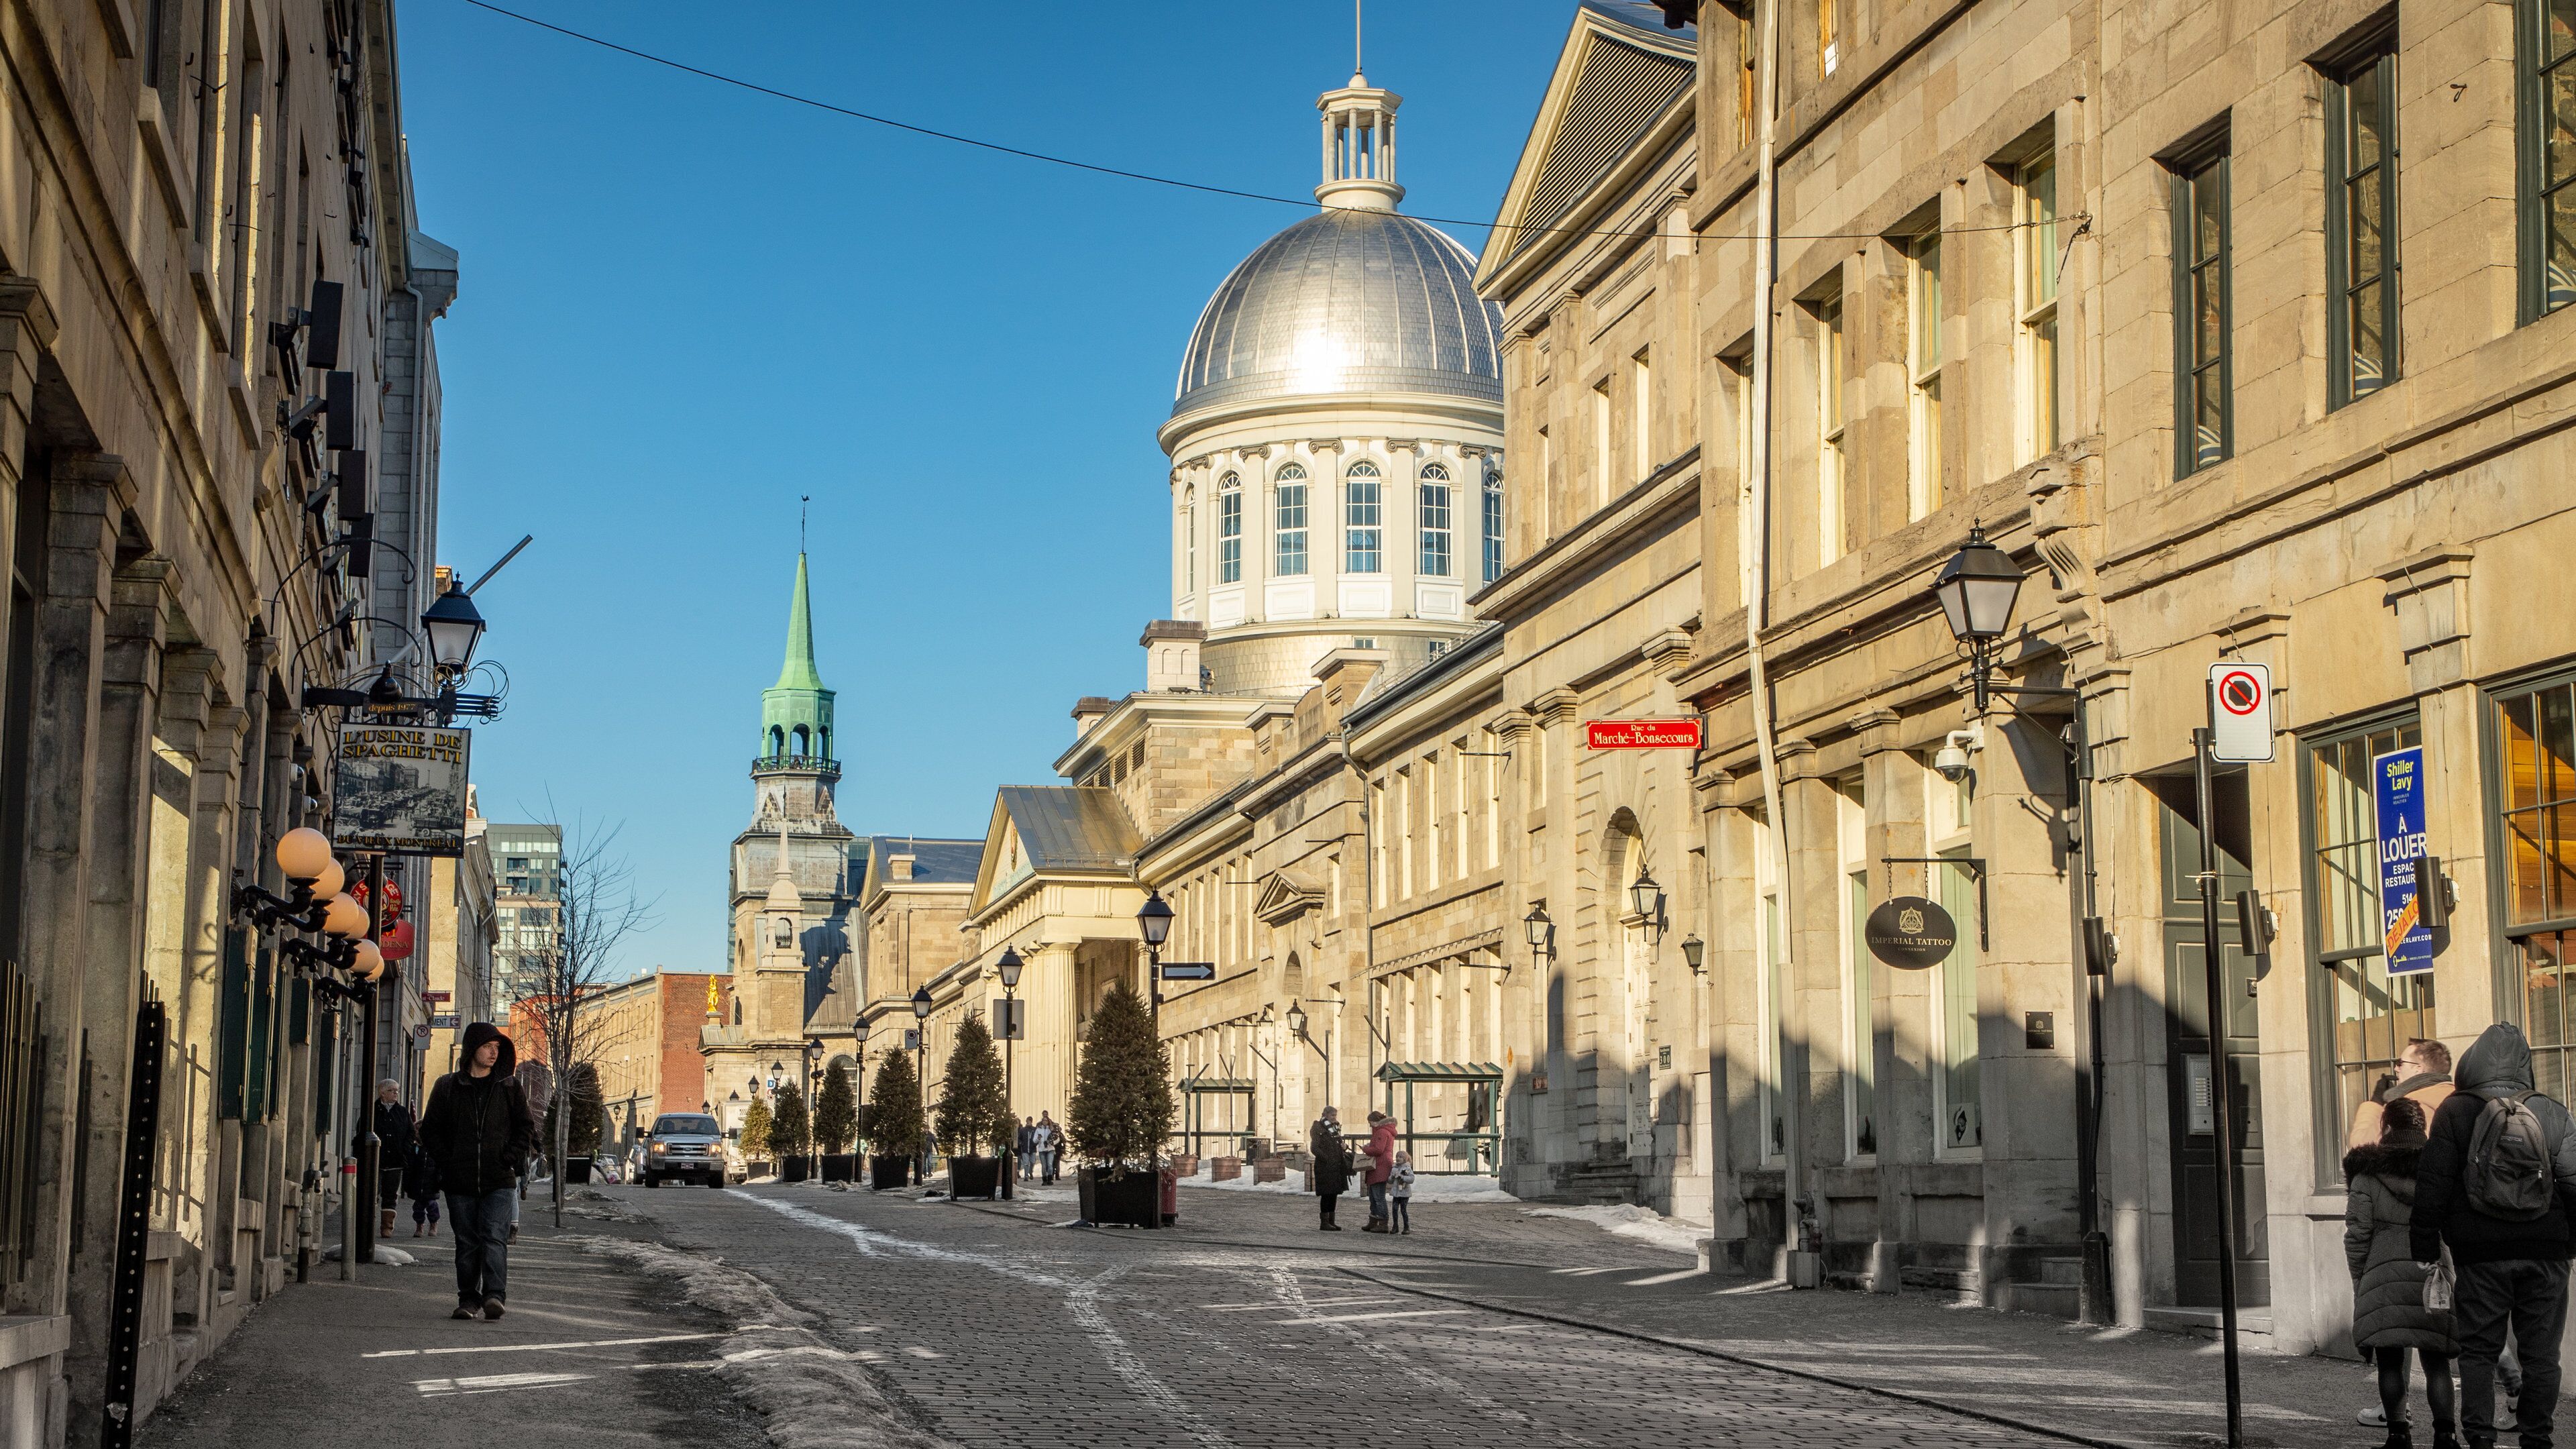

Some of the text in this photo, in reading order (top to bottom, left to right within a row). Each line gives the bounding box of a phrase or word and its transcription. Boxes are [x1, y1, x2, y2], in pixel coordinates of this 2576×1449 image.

[368, 703, 417, 714] depuis 1977
[343, 729, 462, 750] L'USINE DE
[1594, 731, 1694, 745] Marché-Bonsecours
[342, 744, 462, 765] SPAGHETTI
[2387, 759, 2414, 777] Shiller
[2392, 776, 2412, 791] Lavy
[2398, 812, 2408, 834] À
[337, 835, 353, 845] DU
[356, 835, 392, 846] VIEUX
[2381, 832, 2428, 863] LOUER
[2393, 862, 2415, 875] ESPAC
[2385, 873, 2416, 888] RESTAUR
[2402, 893, 2413, 905] 514
[1872, 936, 1952, 946] IMPERIAL TATTOO
[1660, 1055, 1670, 1065] 300
